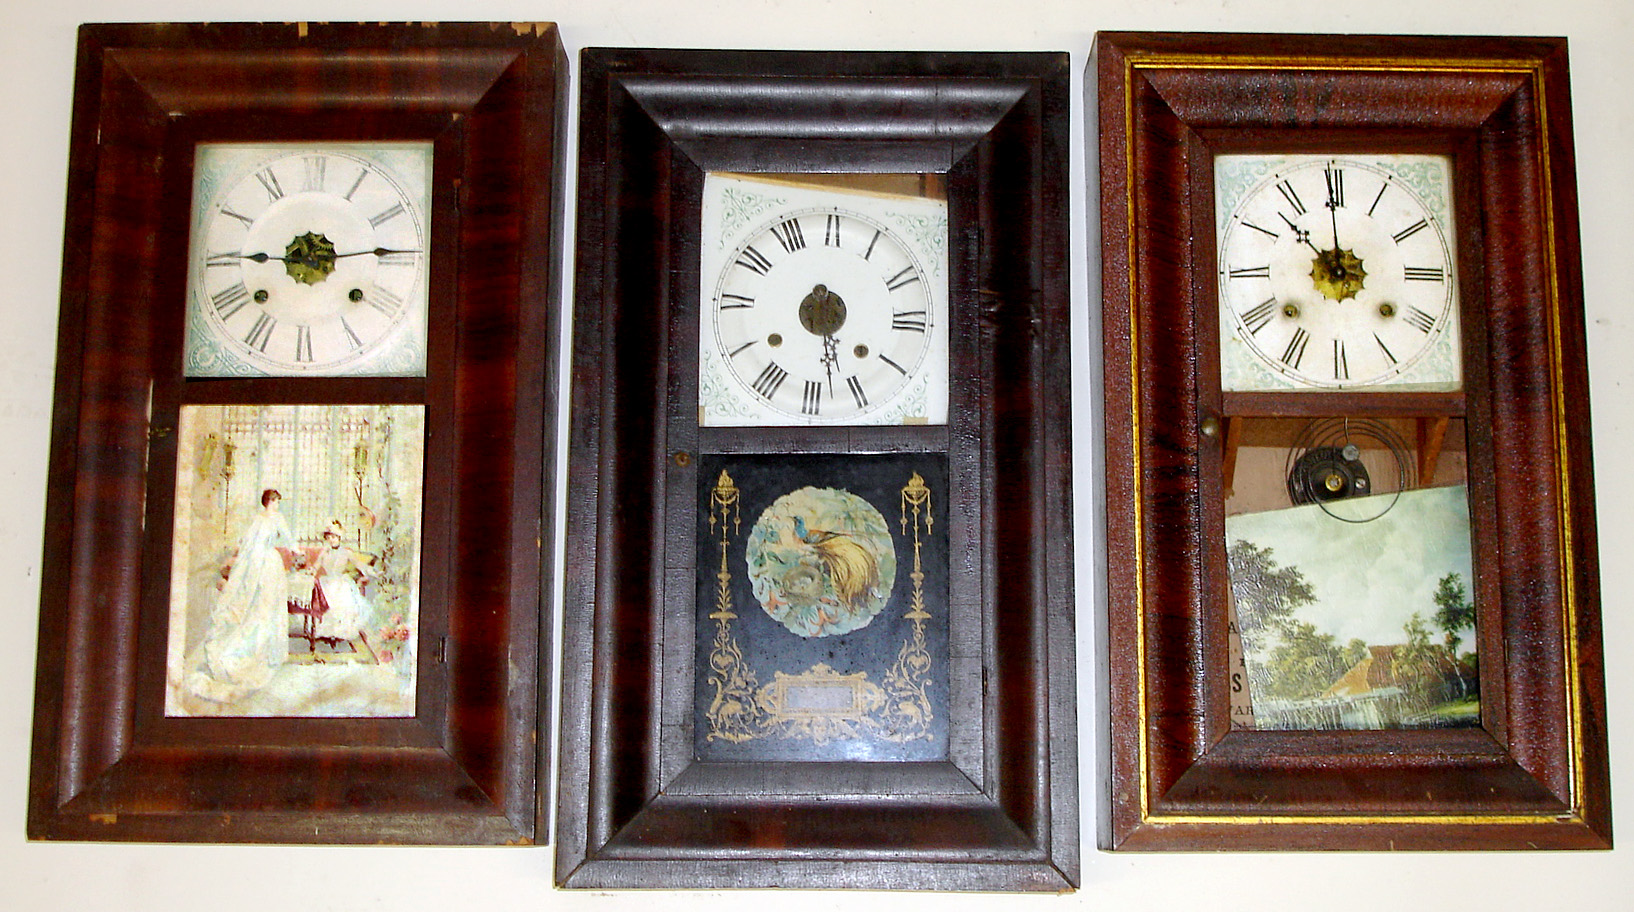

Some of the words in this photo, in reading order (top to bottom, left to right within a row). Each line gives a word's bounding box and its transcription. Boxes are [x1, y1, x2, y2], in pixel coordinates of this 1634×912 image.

[255, 166, 286, 202] XI
[303, 157, 326, 192] XII
[344, 168, 370, 202] I
[1323, 169, 1347, 208] XII
[220, 204, 254, 230] X
[369, 201, 406, 230] II
[1276, 179, 1308, 219] XI
[1366, 182, 1388, 219] I
[1241, 216, 1279, 244] X
[1391, 216, 1430, 246] II
[206, 249, 241, 269] IX
[1229, 264, 1270, 282] IX
[1404, 265, 1444, 284] III
[211, 281, 250, 324] VIII
[364, 282, 403, 319] IIII
[1239, 294, 1278, 339] VIII
[244, 311, 277, 355] VII
[341, 316, 364, 349] V
[1403, 304, 1437, 335] IIII
[295, 325, 314, 362] VI
[1277, 327, 1310, 370] VII
[1333, 339, 1349, 380] VI
[1373, 331, 1397, 369] V
